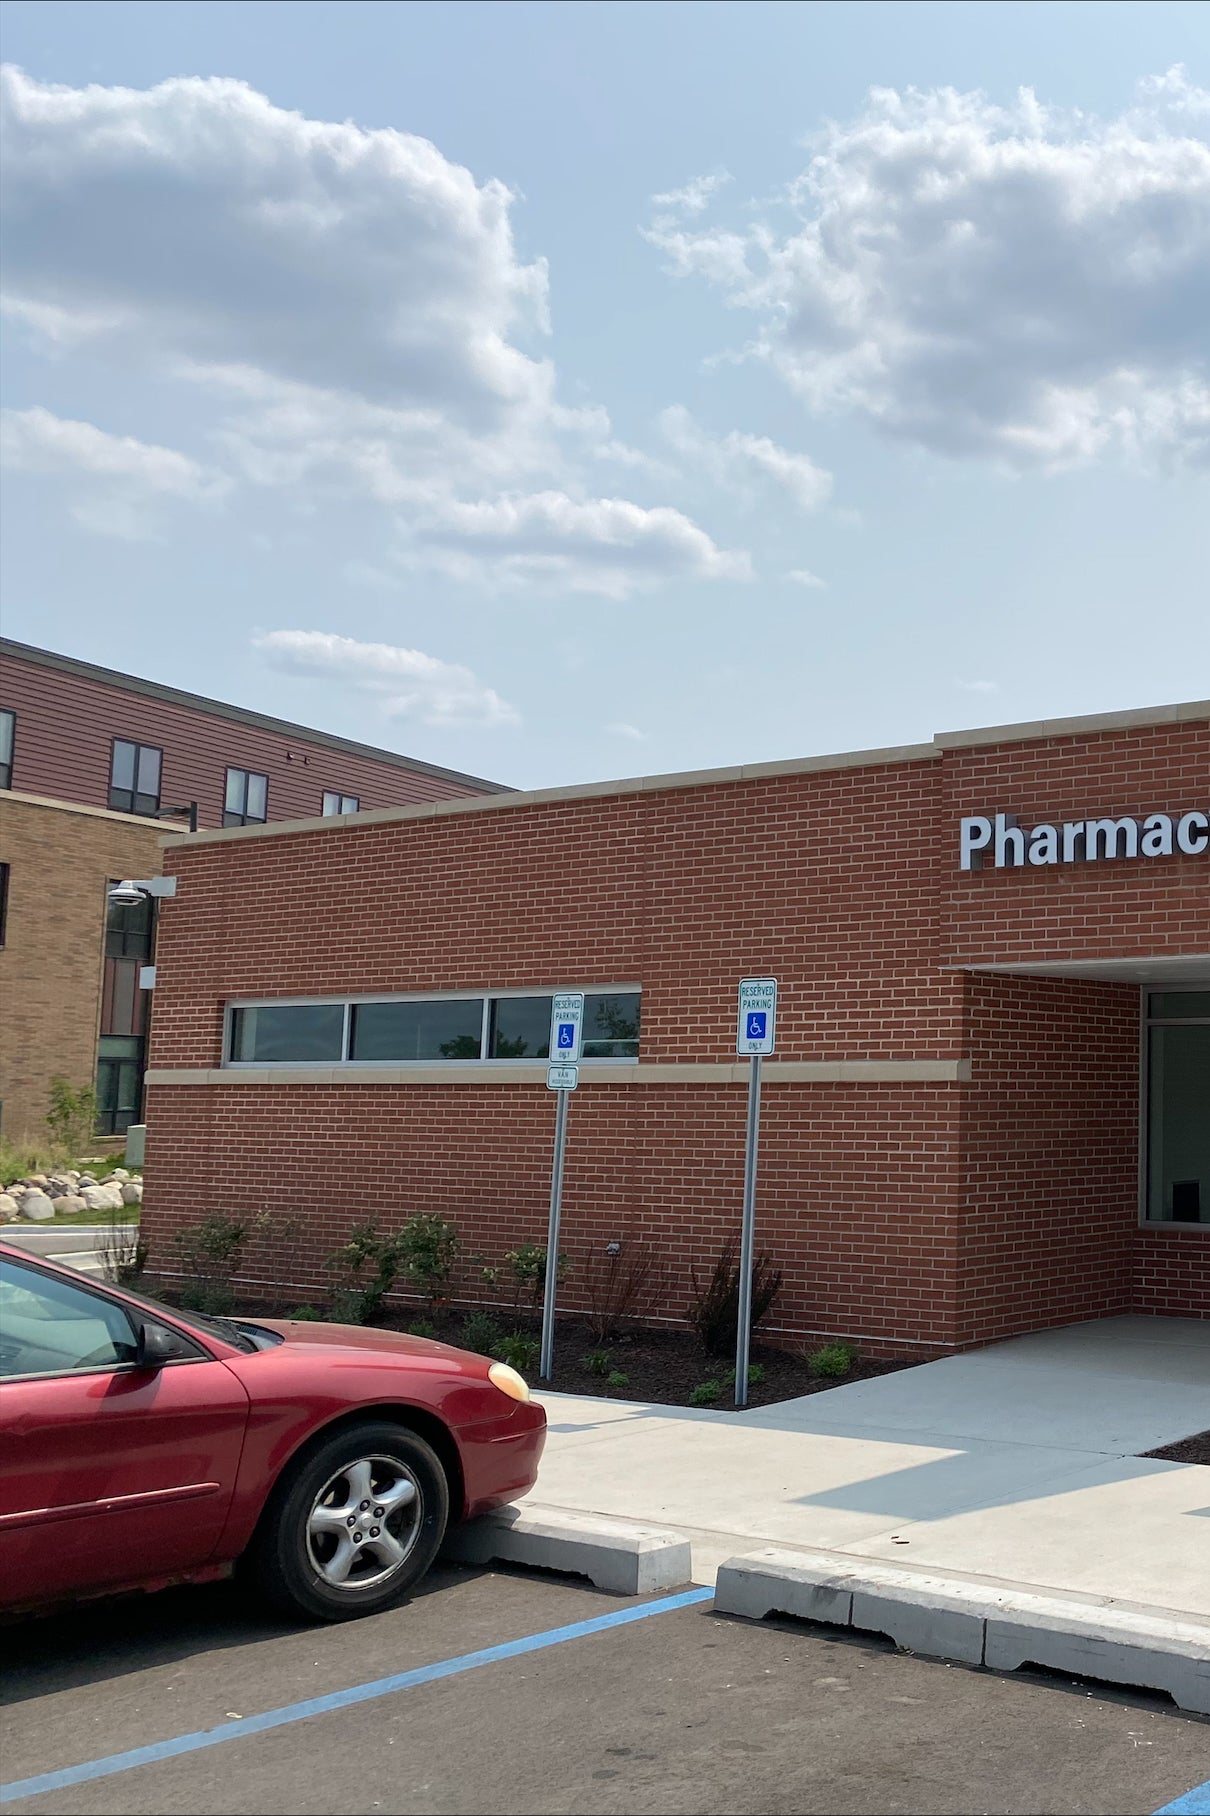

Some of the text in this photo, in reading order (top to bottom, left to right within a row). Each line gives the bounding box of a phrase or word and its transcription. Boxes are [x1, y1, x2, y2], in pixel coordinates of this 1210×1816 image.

[742, 986, 773, 997] RESERVED
[555, 1000, 580, 1009] RESERVED
[743, 999, 772, 1009] PARKING
[555, 1012, 579, 1021] PARKING
[748, 1042, 763, 1050] ONLY
